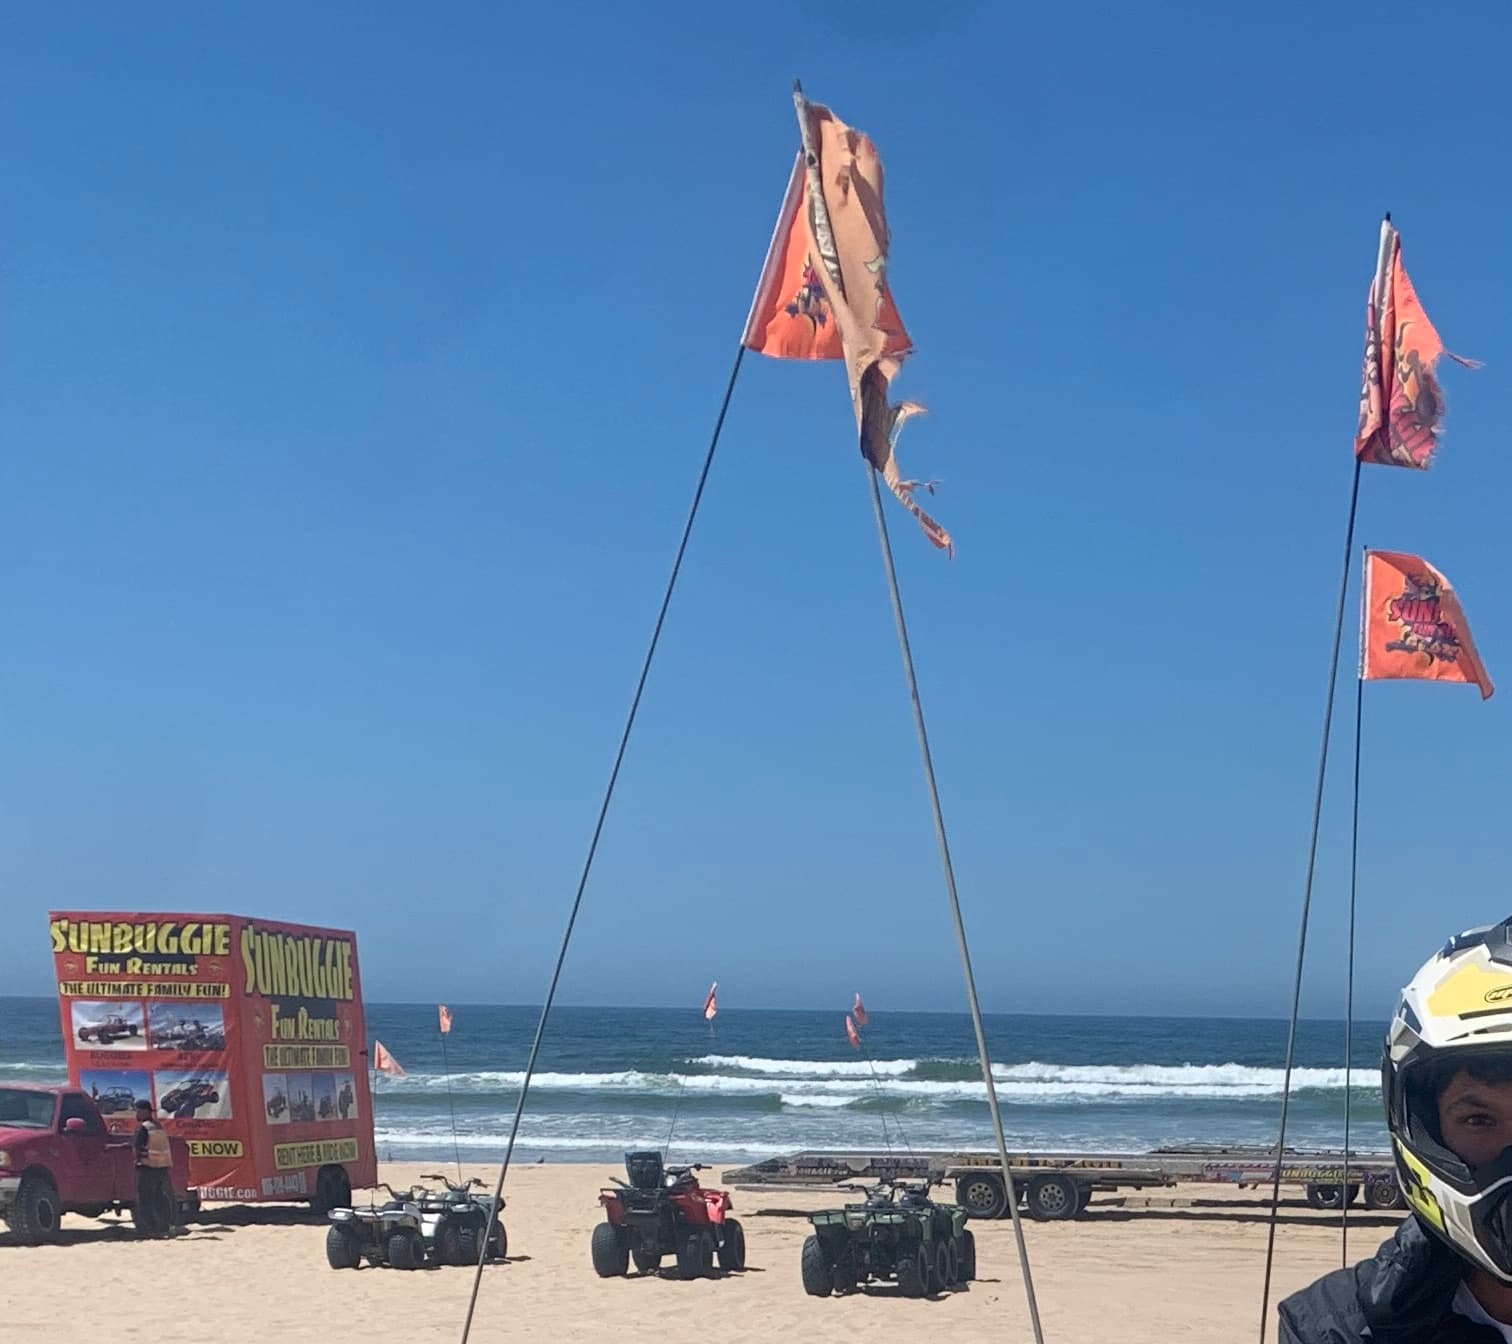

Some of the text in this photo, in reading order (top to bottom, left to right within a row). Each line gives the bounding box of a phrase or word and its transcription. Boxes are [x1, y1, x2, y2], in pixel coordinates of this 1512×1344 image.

[51, 919, 231, 955] SUNBUGGIE
[241, 924, 353, 999] SUNBUGGIE
[63, 983, 226, 996] THE ULTIMATE FAMILY FUN!
[202, 1143, 239, 1155] NOW
